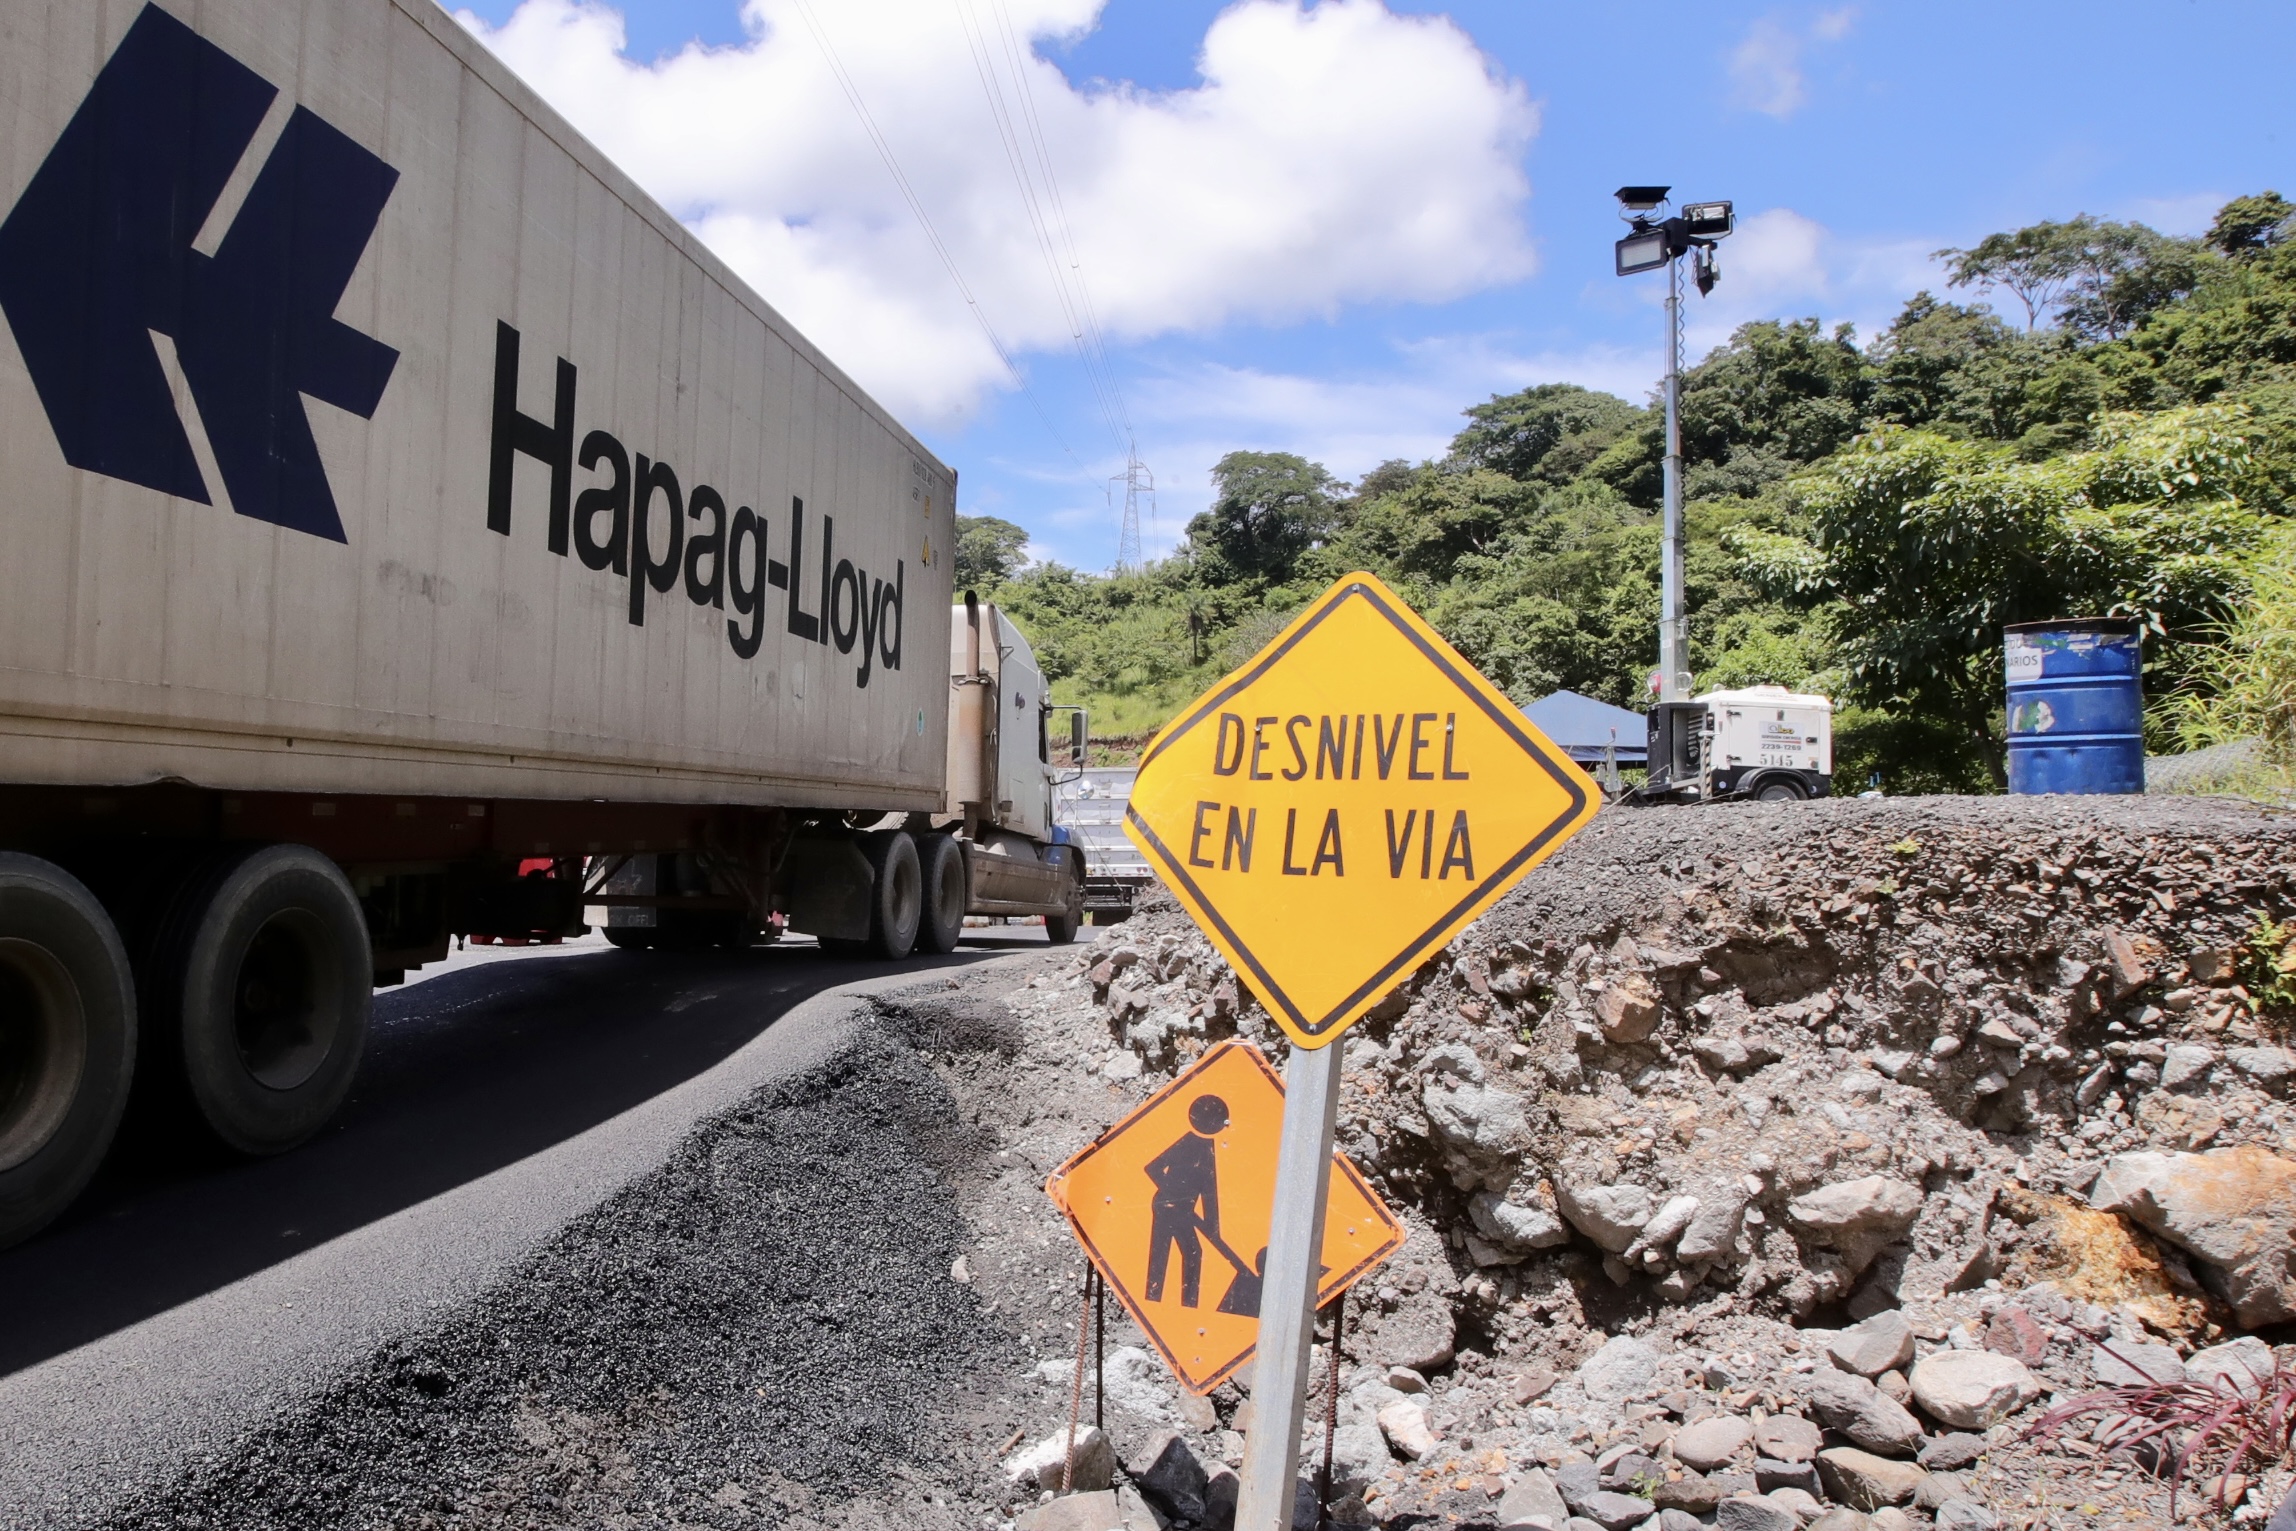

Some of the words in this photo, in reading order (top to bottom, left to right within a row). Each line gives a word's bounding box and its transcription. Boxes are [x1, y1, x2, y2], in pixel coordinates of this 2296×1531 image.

[487, 319, 903, 688] Hapag-Lloyd
[1216, 713, 1468, 780] DESNIVEL
[1760, 754, 1793, 767] 5145
[1190, 801, 1256, 873] EN
[1283, 809, 1344, 876] LA
[1386, 809, 1474, 881] VIA
